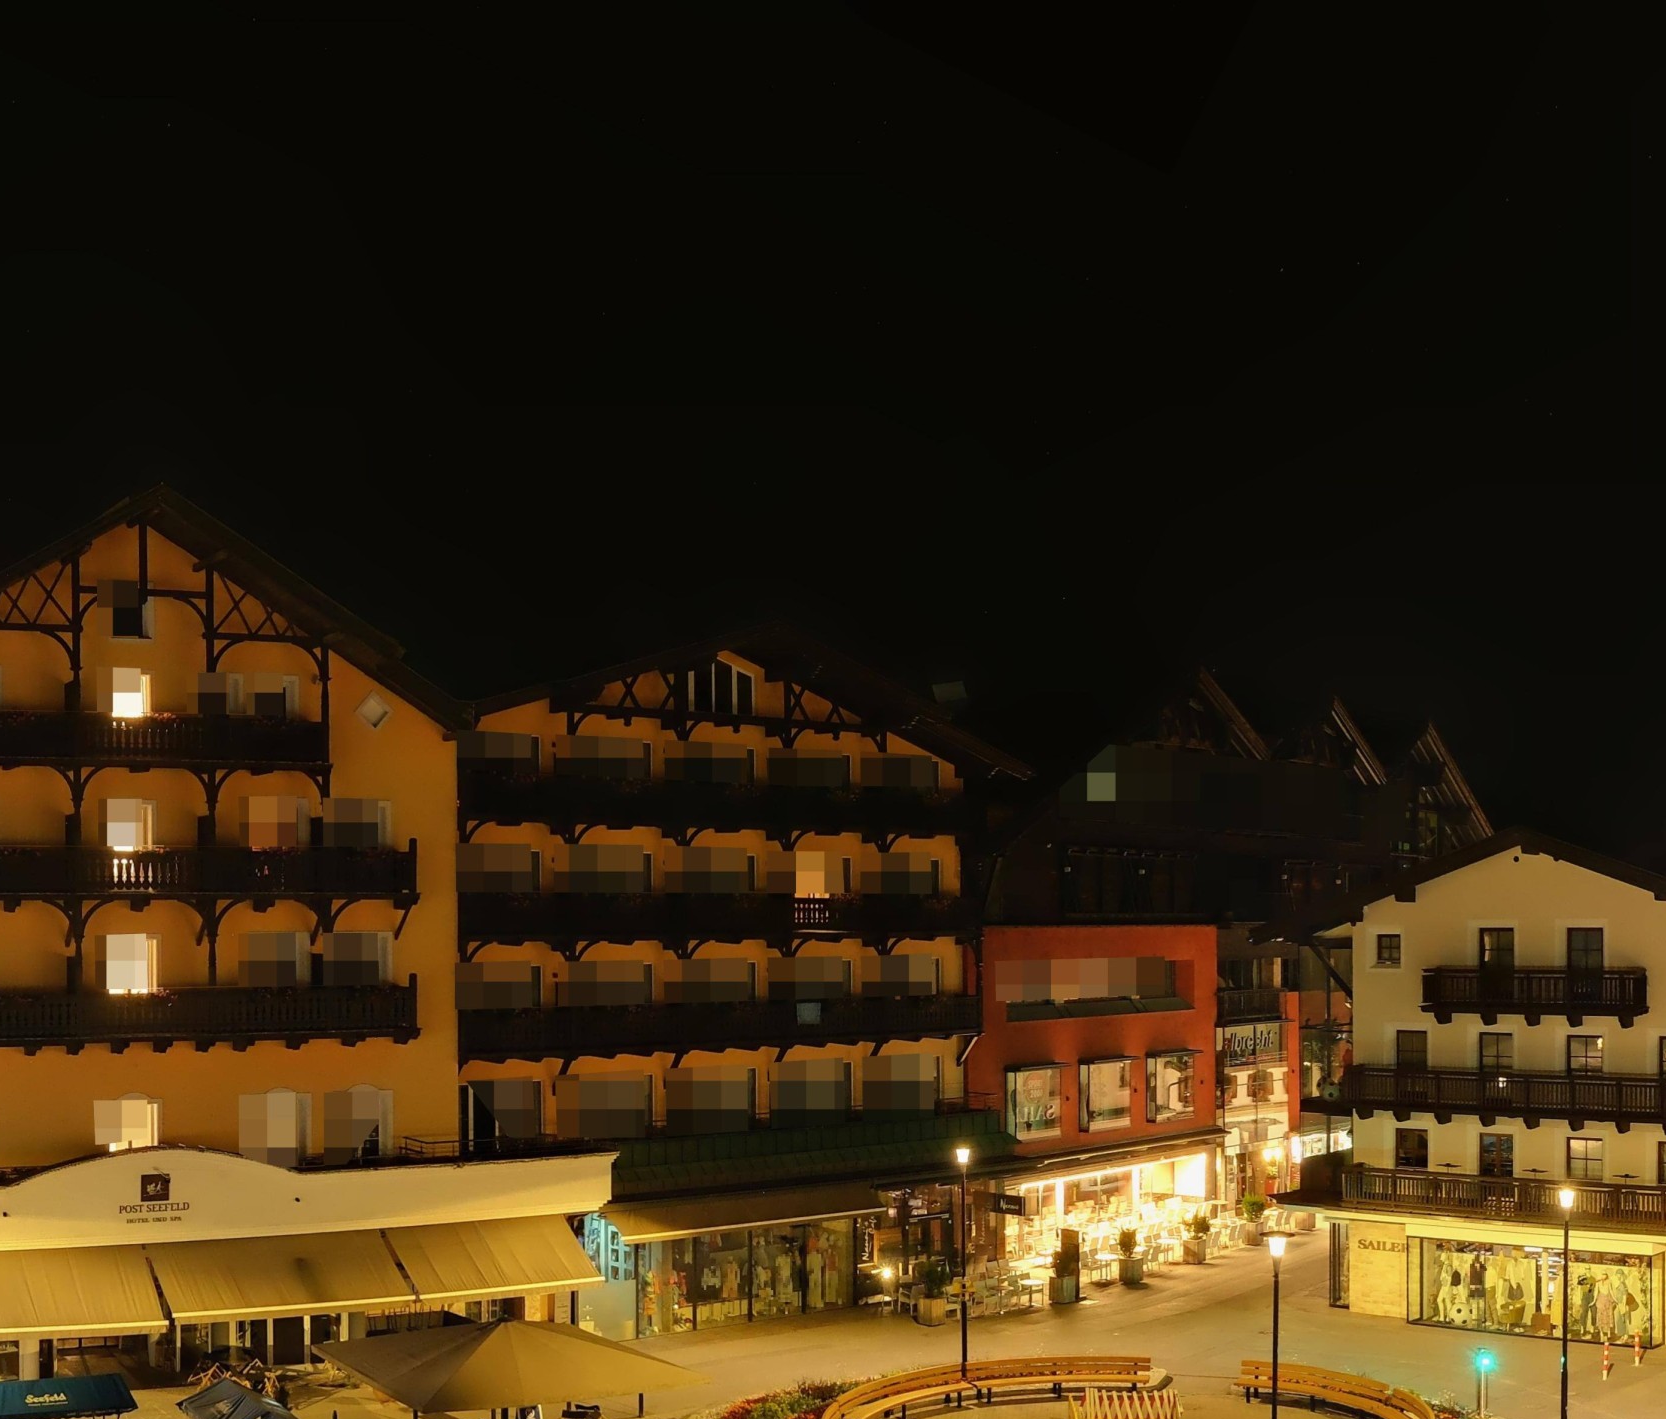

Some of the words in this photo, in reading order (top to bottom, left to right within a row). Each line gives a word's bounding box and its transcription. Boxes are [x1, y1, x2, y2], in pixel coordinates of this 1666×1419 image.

[119, 1204, 144, 1214] POST
[146, 1202, 190, 1213] SEEFELD
[25, 1392, 67, 1405] Seefeld
